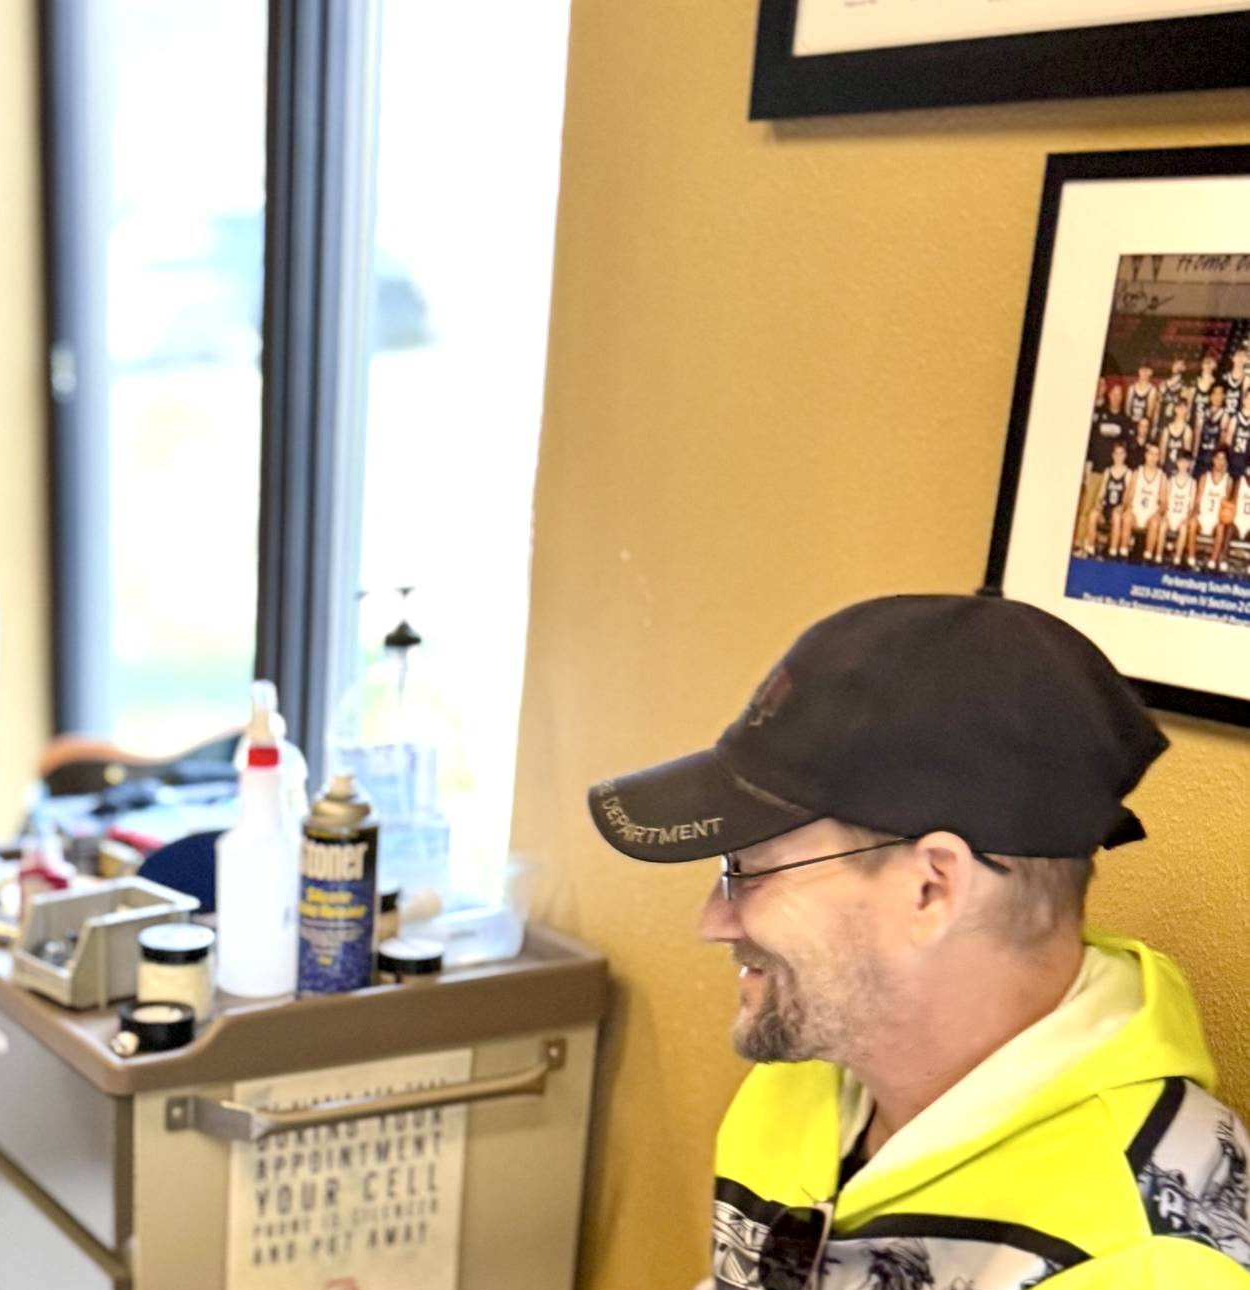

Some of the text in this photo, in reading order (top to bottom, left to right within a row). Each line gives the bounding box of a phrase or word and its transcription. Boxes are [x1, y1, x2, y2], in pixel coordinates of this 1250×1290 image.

[602, 796, 723, 845] DEPARTMENT
[255, 1131, 442, 1181] APPOINTMENT
[255, 1162, 438, 1217] YOUR CELL
